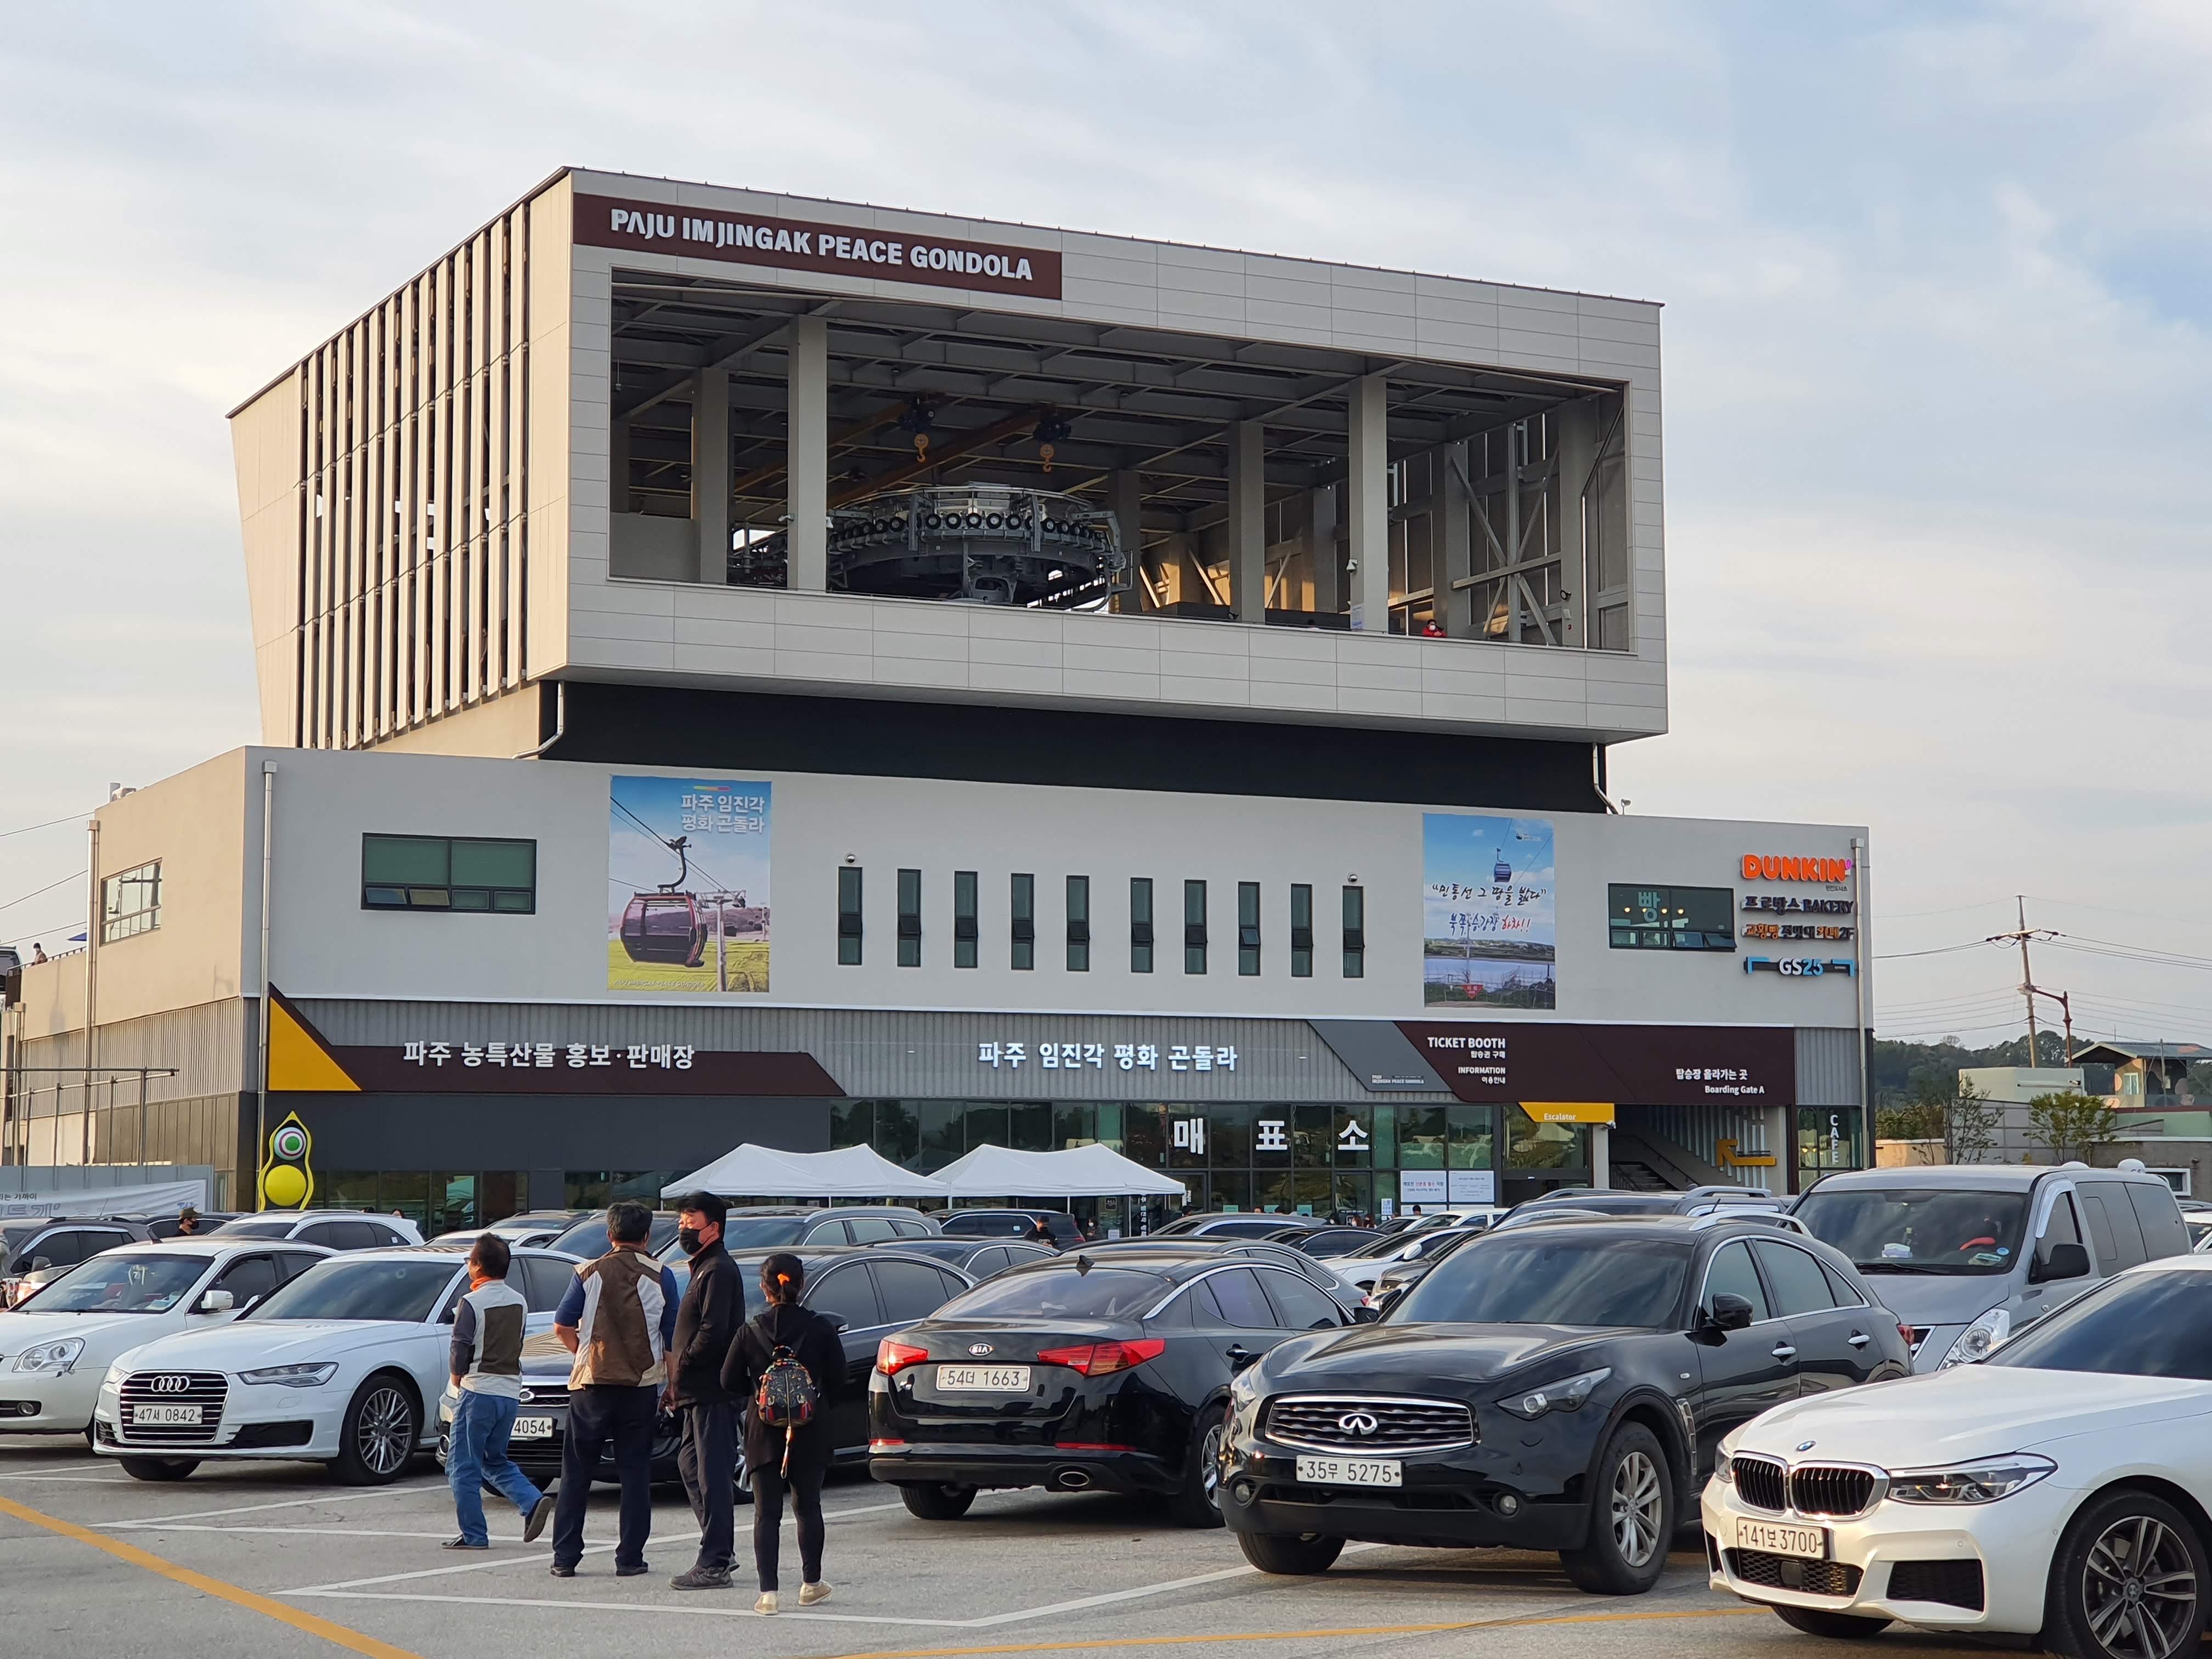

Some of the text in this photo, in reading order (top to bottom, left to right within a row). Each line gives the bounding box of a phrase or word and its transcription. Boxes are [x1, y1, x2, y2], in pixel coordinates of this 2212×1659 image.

[611, 208, 1032, 280] PAJU IMJINGAK PEACE GONDOLA
[681, 794, 765, 812] 파주 임진각
[681, 814, 764, 833] 평화 곤돌라
[1477, 887, 1487, 897] 그
[1492, 885, 1514, 905] 땅을
[1638, 891, 1661, 922] 빵
[1803, 899, 1854, 913] BAKERY
[1779, 958, 1824, 976] GS25
[1427, 1037, 1505, 1048] TICKET BOOTH
[403, 1041, 452, 1066] 파주
[461, 1042, 556, 1068] 농특산물
[979, 1042, 1238, 1071] 파주 임진각 평화 곤돌라
[1676, 1068, 1748, 1080] 탑승장 올라가는 곳
[1705, 1085, 1765, 1096] Boarding Gate A
[1544, 1113, 1576, 1121] Escalator
[1173, 1118, 1370, 1155] 매표소
[1830, 1114, 1839, 1164] CAFE
[14, 1193, 37, 1201] 가까이
[947, 1370, 1019, 1386] 54더 1663
[139, 1408, 195, 1421] 47서 0842
[514, 1420, 545, 1434] 4054
[1307, 1461, 1391, 1482] 35무 5275
[1743, 1524, 1816, 1553] 141보 3700
